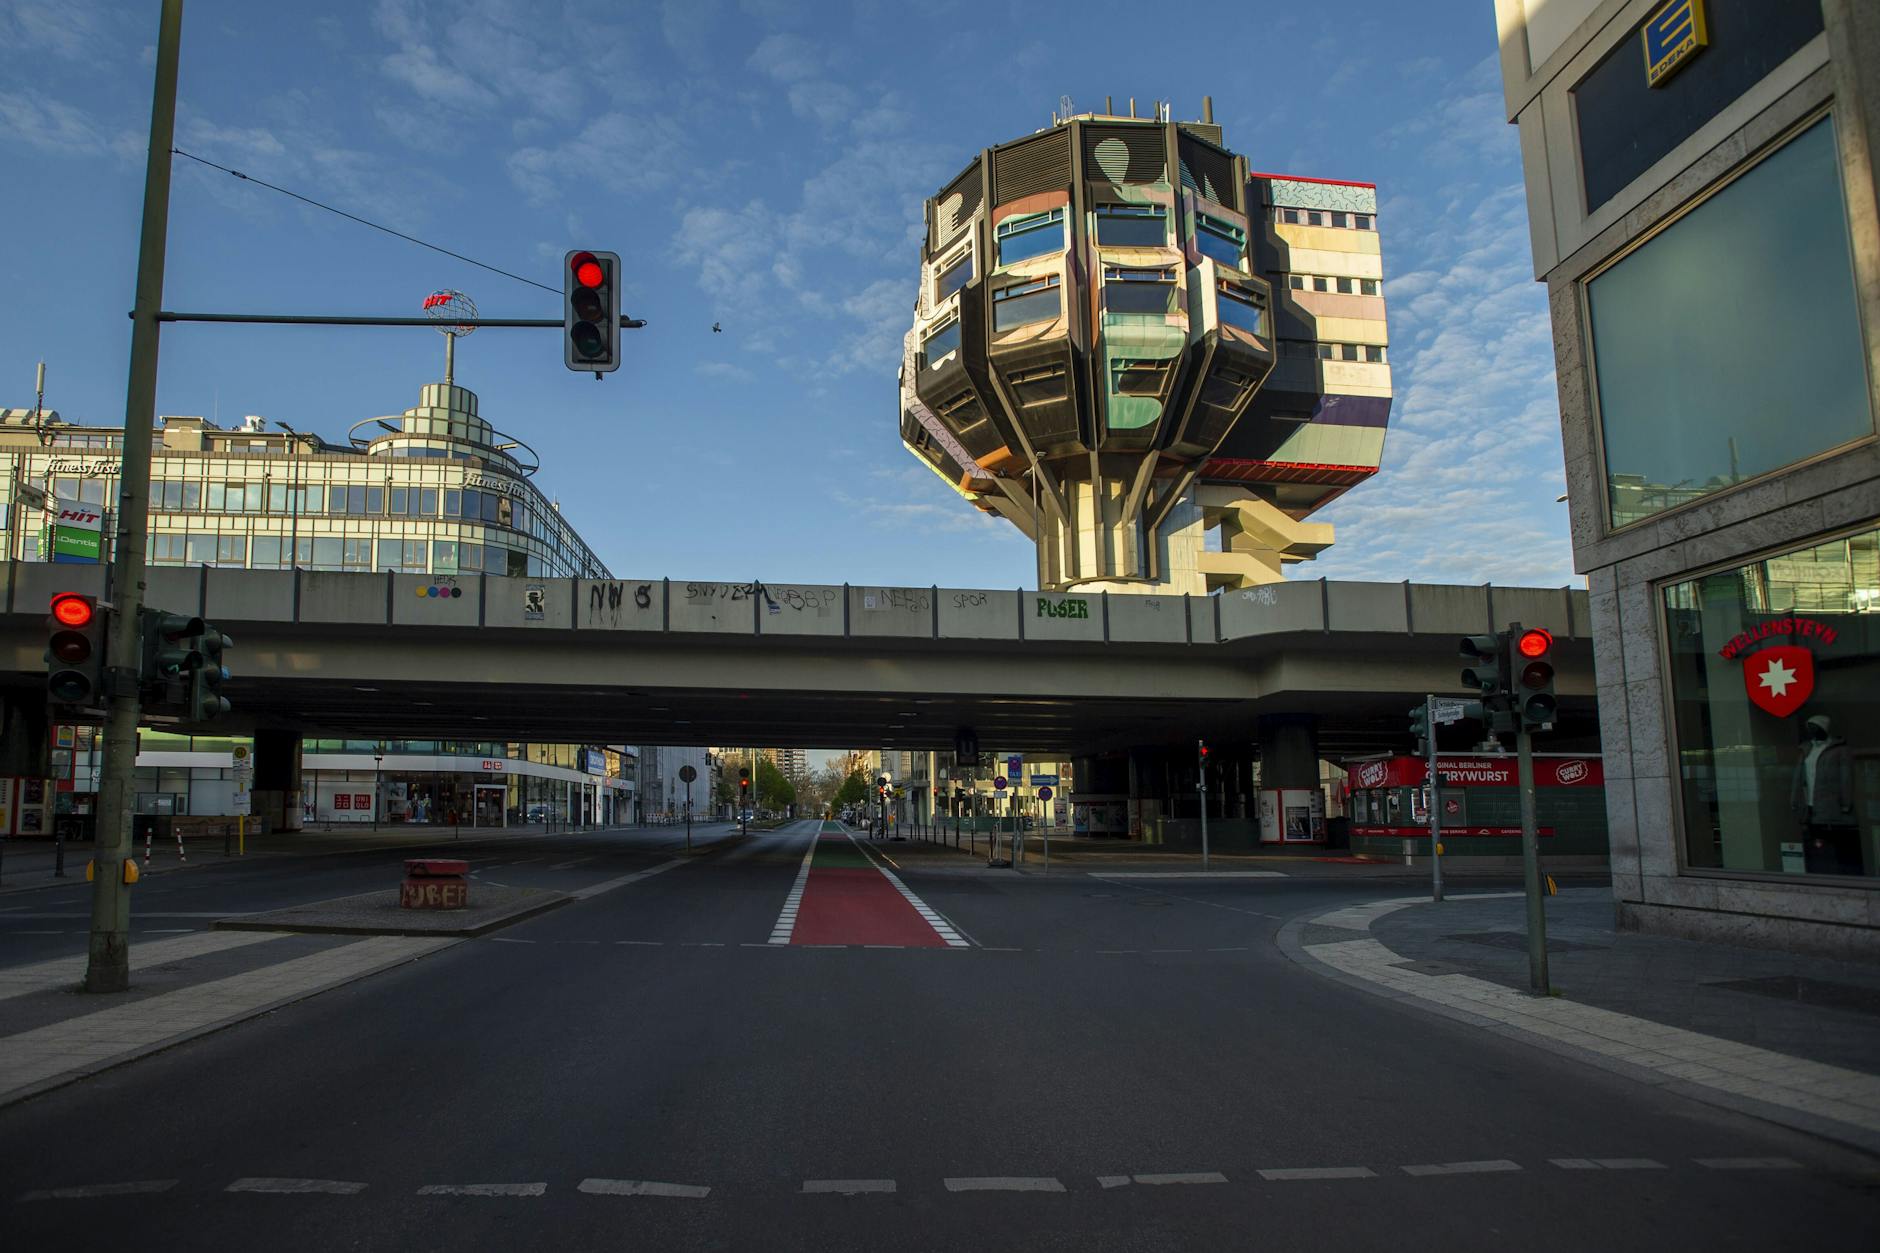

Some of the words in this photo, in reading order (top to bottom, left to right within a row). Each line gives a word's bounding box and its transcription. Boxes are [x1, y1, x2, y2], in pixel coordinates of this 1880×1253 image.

[1650, 38, 1694, 80] EDEKA
[59, 509, 100, 523] HIT
[1719, 618, 1838, 661] WELLENSTEYN
[1361, 761, 1384, 779] CURRY
[1425, 771, 1509, 782] CRRYWURST
[1559, 762, 1583, 776] CURRY
[1562, 769, 1583, 781] WOLF
[1363, 771, 1385, 788] WOLF
